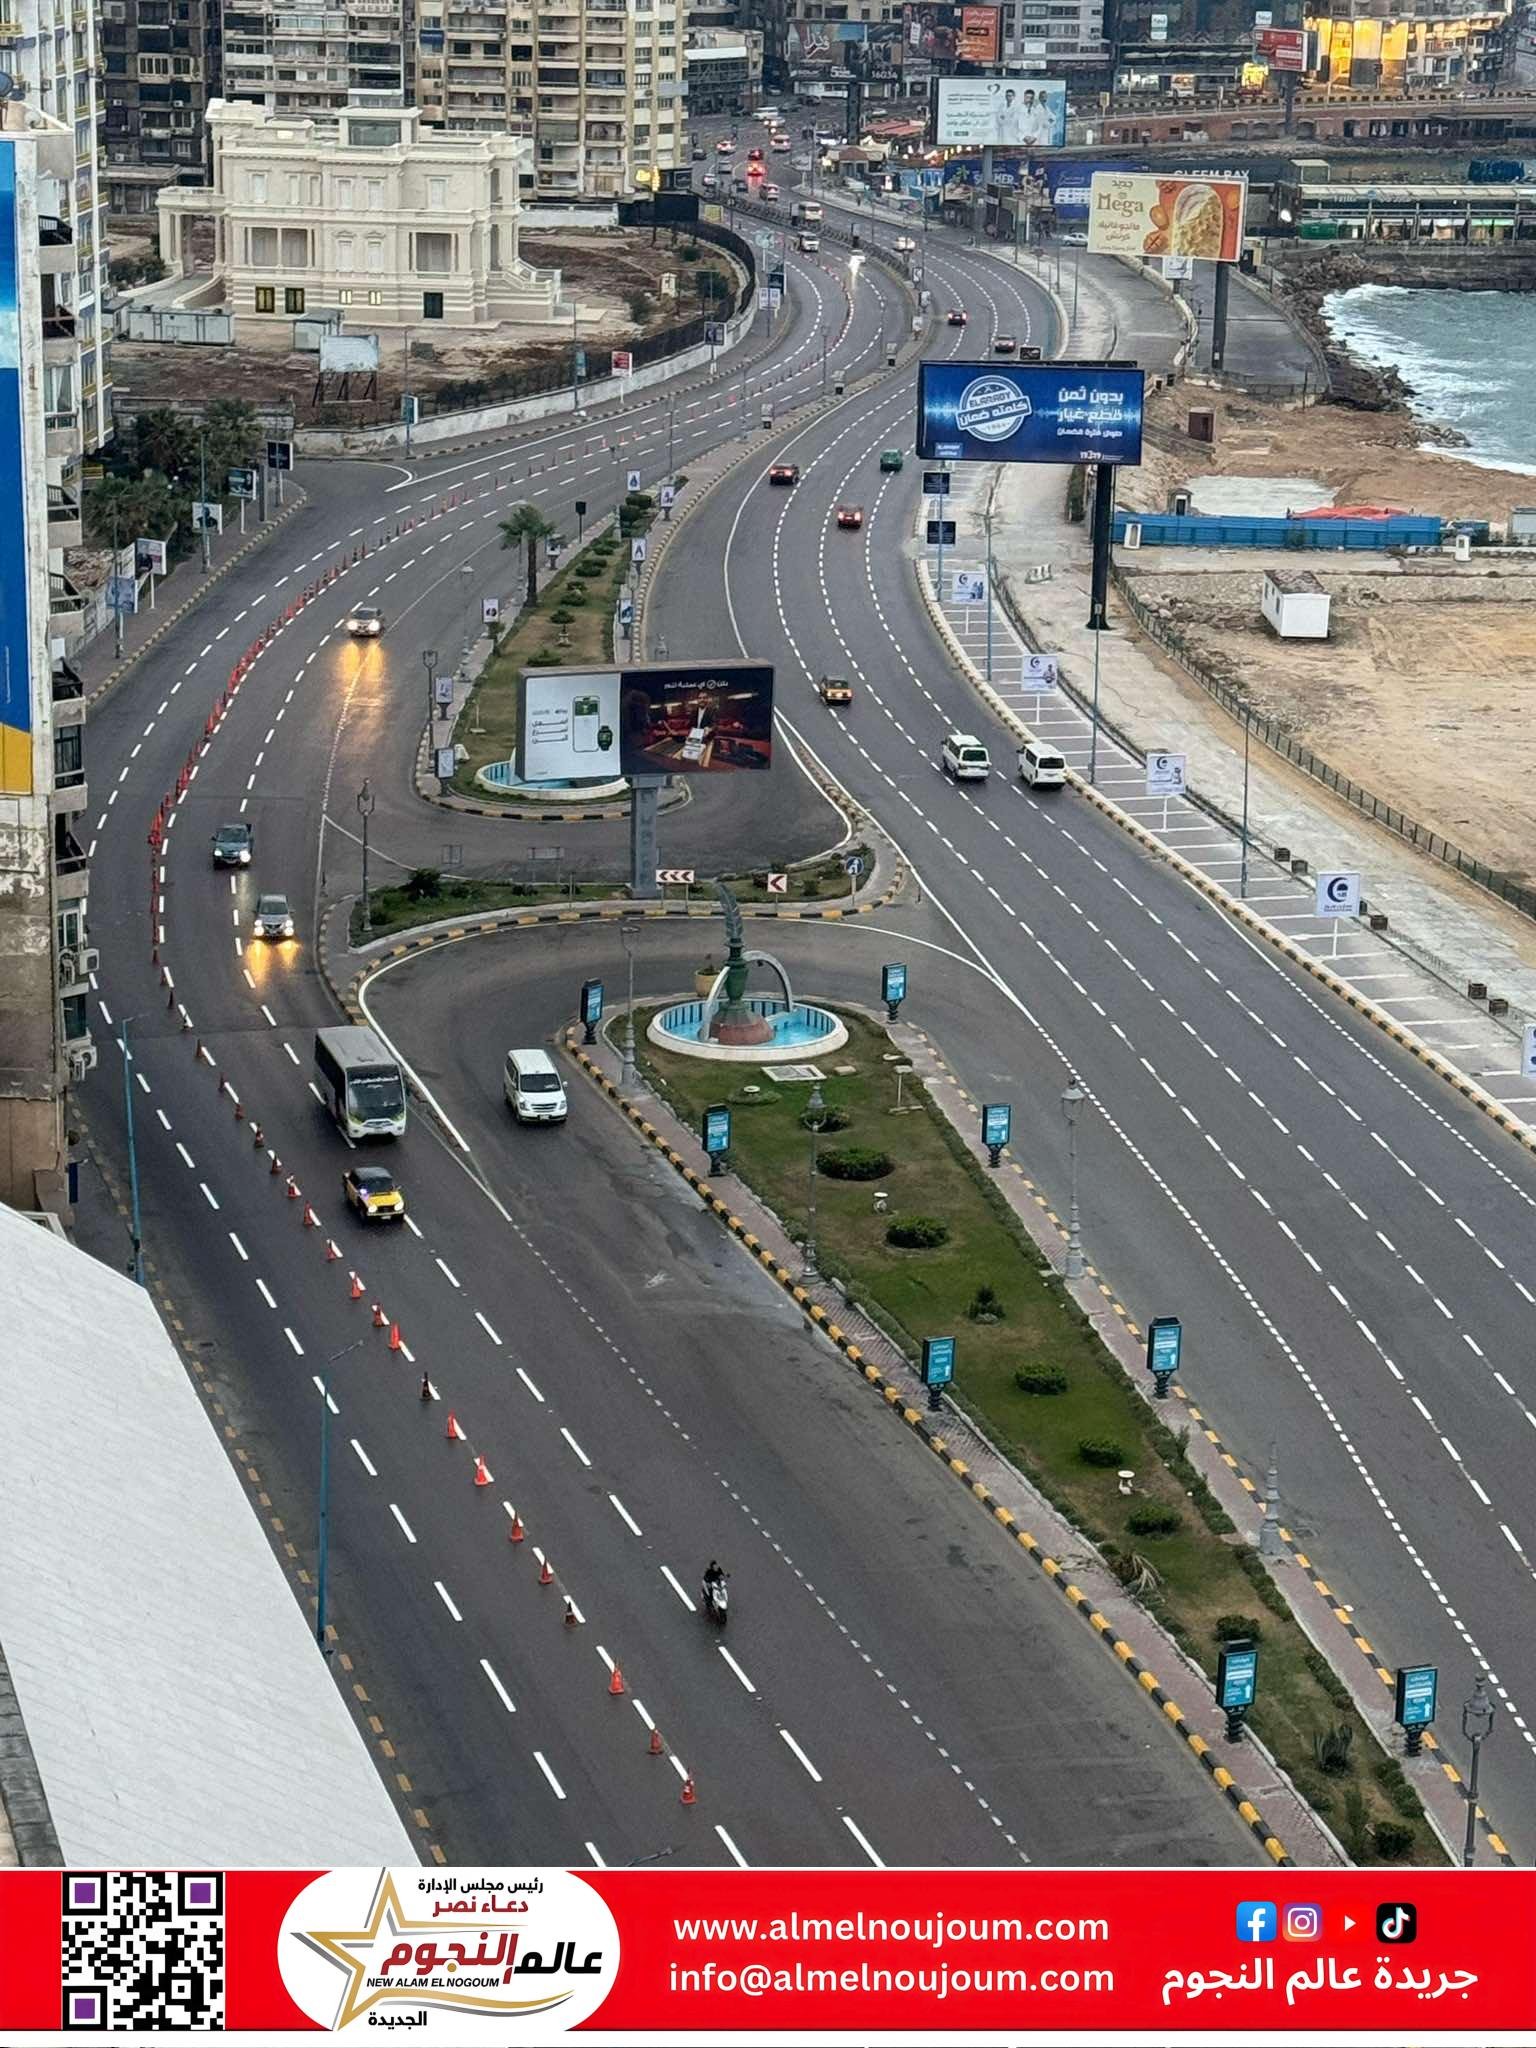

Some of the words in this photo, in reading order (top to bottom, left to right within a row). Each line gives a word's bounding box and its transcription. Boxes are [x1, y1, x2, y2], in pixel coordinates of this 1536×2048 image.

[1096, 191, 1144, 218] Mega
[1058, 385, 1087, 403] ثمن
[1090, 388, 1123, 405] بدون
[991, 400, 1028, 418] كلمته
[1057, 408, 1087, 422] غيار
[1088, 407, 1122, 423] قطع
[959, 410, 991, 426] ضمان
